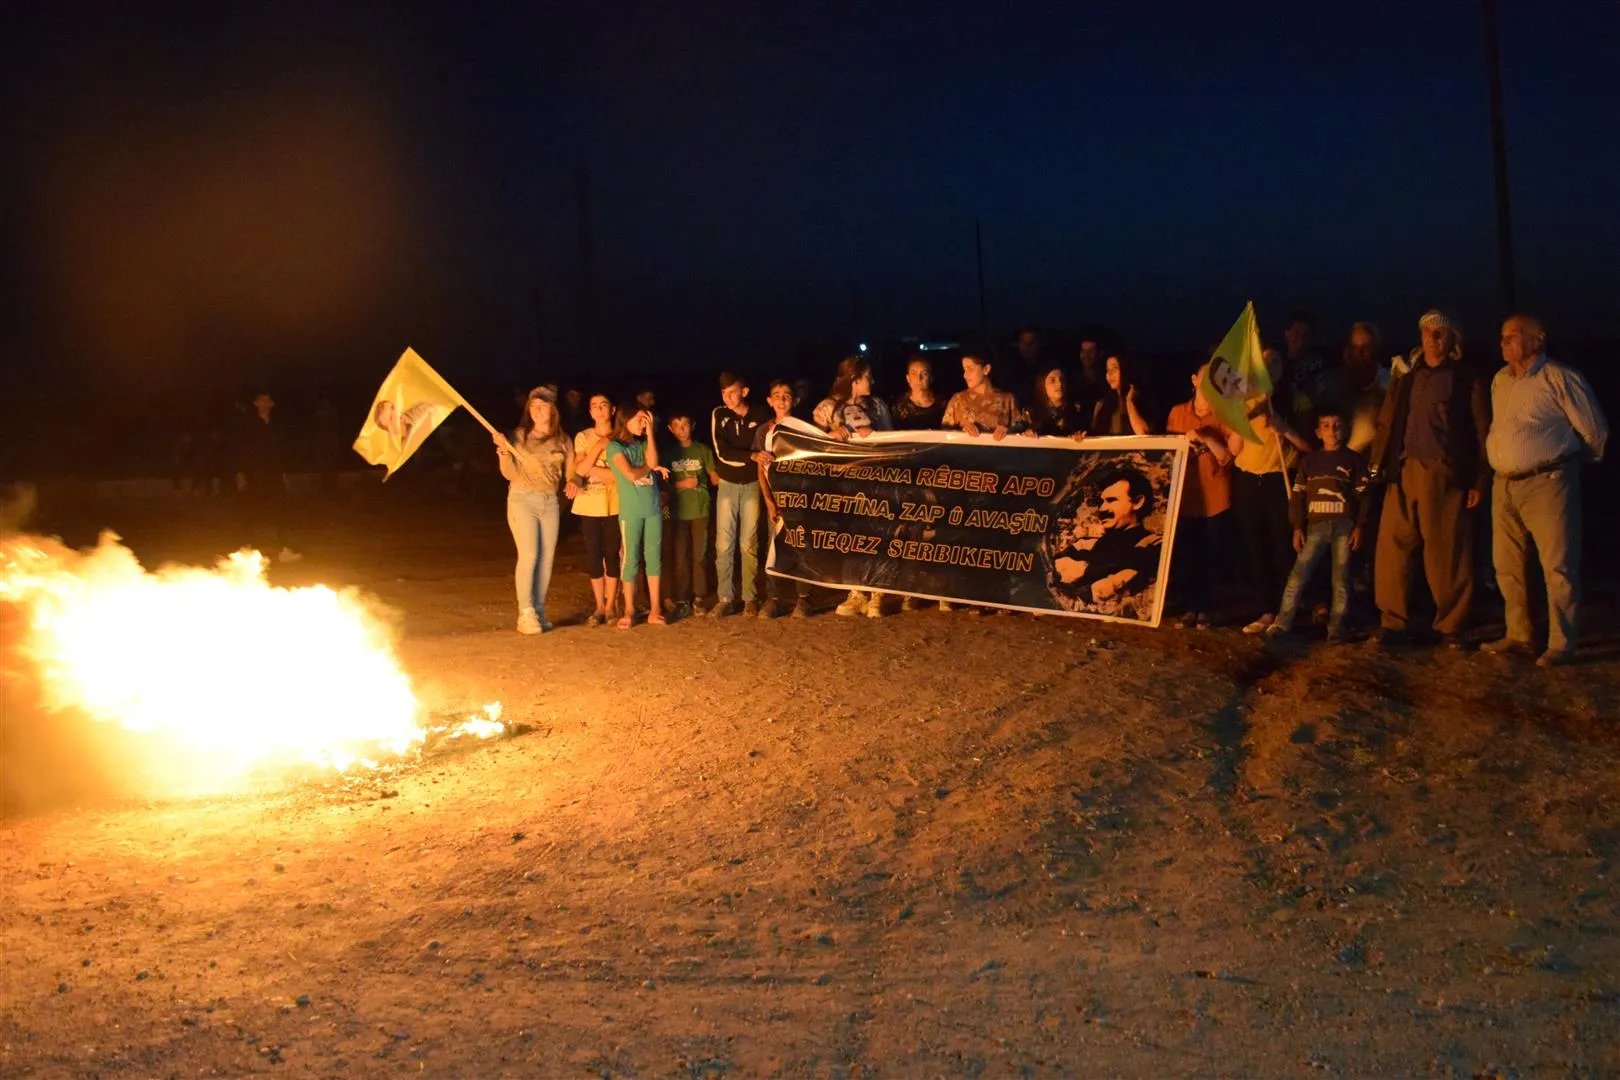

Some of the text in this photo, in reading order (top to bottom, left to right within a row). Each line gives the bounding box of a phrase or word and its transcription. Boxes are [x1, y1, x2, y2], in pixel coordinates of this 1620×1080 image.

[776, 460, 1055, 497] BERXWEDANA RÊBER APO
[774, 491, 808, 509] ETA
[899, 502, 945, 523] ZAP
[948, 506, 964, 526] Û
[965, 508, 1048, 535] AVAŞÎN
[811, 530, 882, 554] TEQEZ
[887, 539, 1034, 572] SERBIKEVIN
